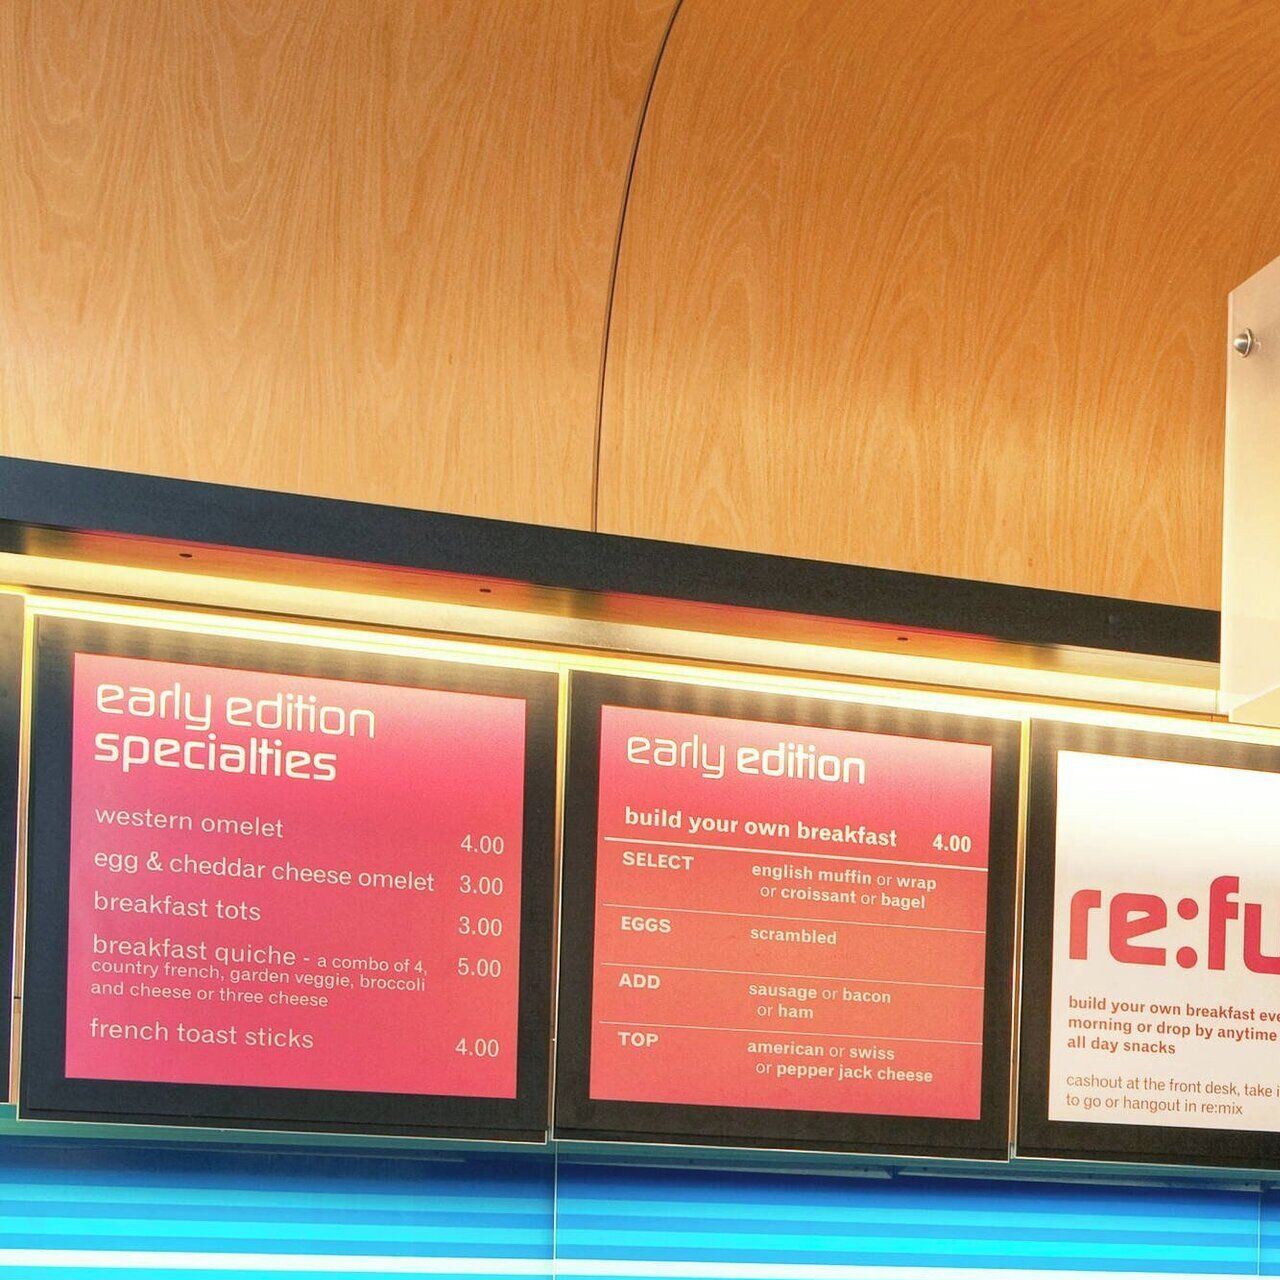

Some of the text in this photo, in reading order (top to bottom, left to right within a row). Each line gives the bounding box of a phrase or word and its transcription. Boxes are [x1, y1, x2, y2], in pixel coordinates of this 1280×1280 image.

[96, 682, 375, 739] early edition
[94, 732, 337, 782] specialties
[627, 734, 866, 785] early edition
[95, 808, 505, 855] western omelet 4.00
[625, 805, 972, 853] build your own breakfast 4.00
[94, 851, 504, 896] egg & cheddar cheese omelet 3.00
[622, 851, 937, 893] SELECT english muffin or wrap
[94, 890, 503, 937] breakfast tots 3.00
[759, 886, 926, 911] or croissant or bagel
[621, 915, 837, 945] EGGS scrambled
[93, 933, 502, 978] breakfast quiche combo 5.00
[91, 960, 427, 992] country french, garden veggie, broccoli
[618, 972, 891, 1004] ADD sausage bacon
[90, 981, 329, 1008] and cheese or three cheese
[1068, 994, 1107, 1011] build
[1111, 1001, 1146, 1015] your
[1149, 1004, 1181, 1016] own
[1186, 1003, 1256, 1021] breakfast
[778, 1003, 814, 1019] ham
[89, 1017, 500, 1058] french toast sticks 4.00
[1067, 1035, 1176, 1055] all day snacks
[1068, 1017, 1132, 1035] morning
[1136, 1022, 1153, 1033] or
[1156, 1020, 1191, 1039] drop
[1195, 1023, 1214, 1040] by
[1217, 1026, 1278, 1042] anytime
[617, 1031, 895, 1061] TOP american or swiss
[755, 1062, 933, 1083] or pepper jack cheese
[1066, 1073, 1123, 1089] cashout
[1126, 1076, 1140, 1090] at
[1143, 1076, 1166, 1091] the
[1169, 1078, 1202, 1094] front
[1205, 1080, 1241, 1097] desk,
[1243, 1083, 1273, 1098] take
[1065, 1093, 1243, 1115] to go or hangout in re:mix
